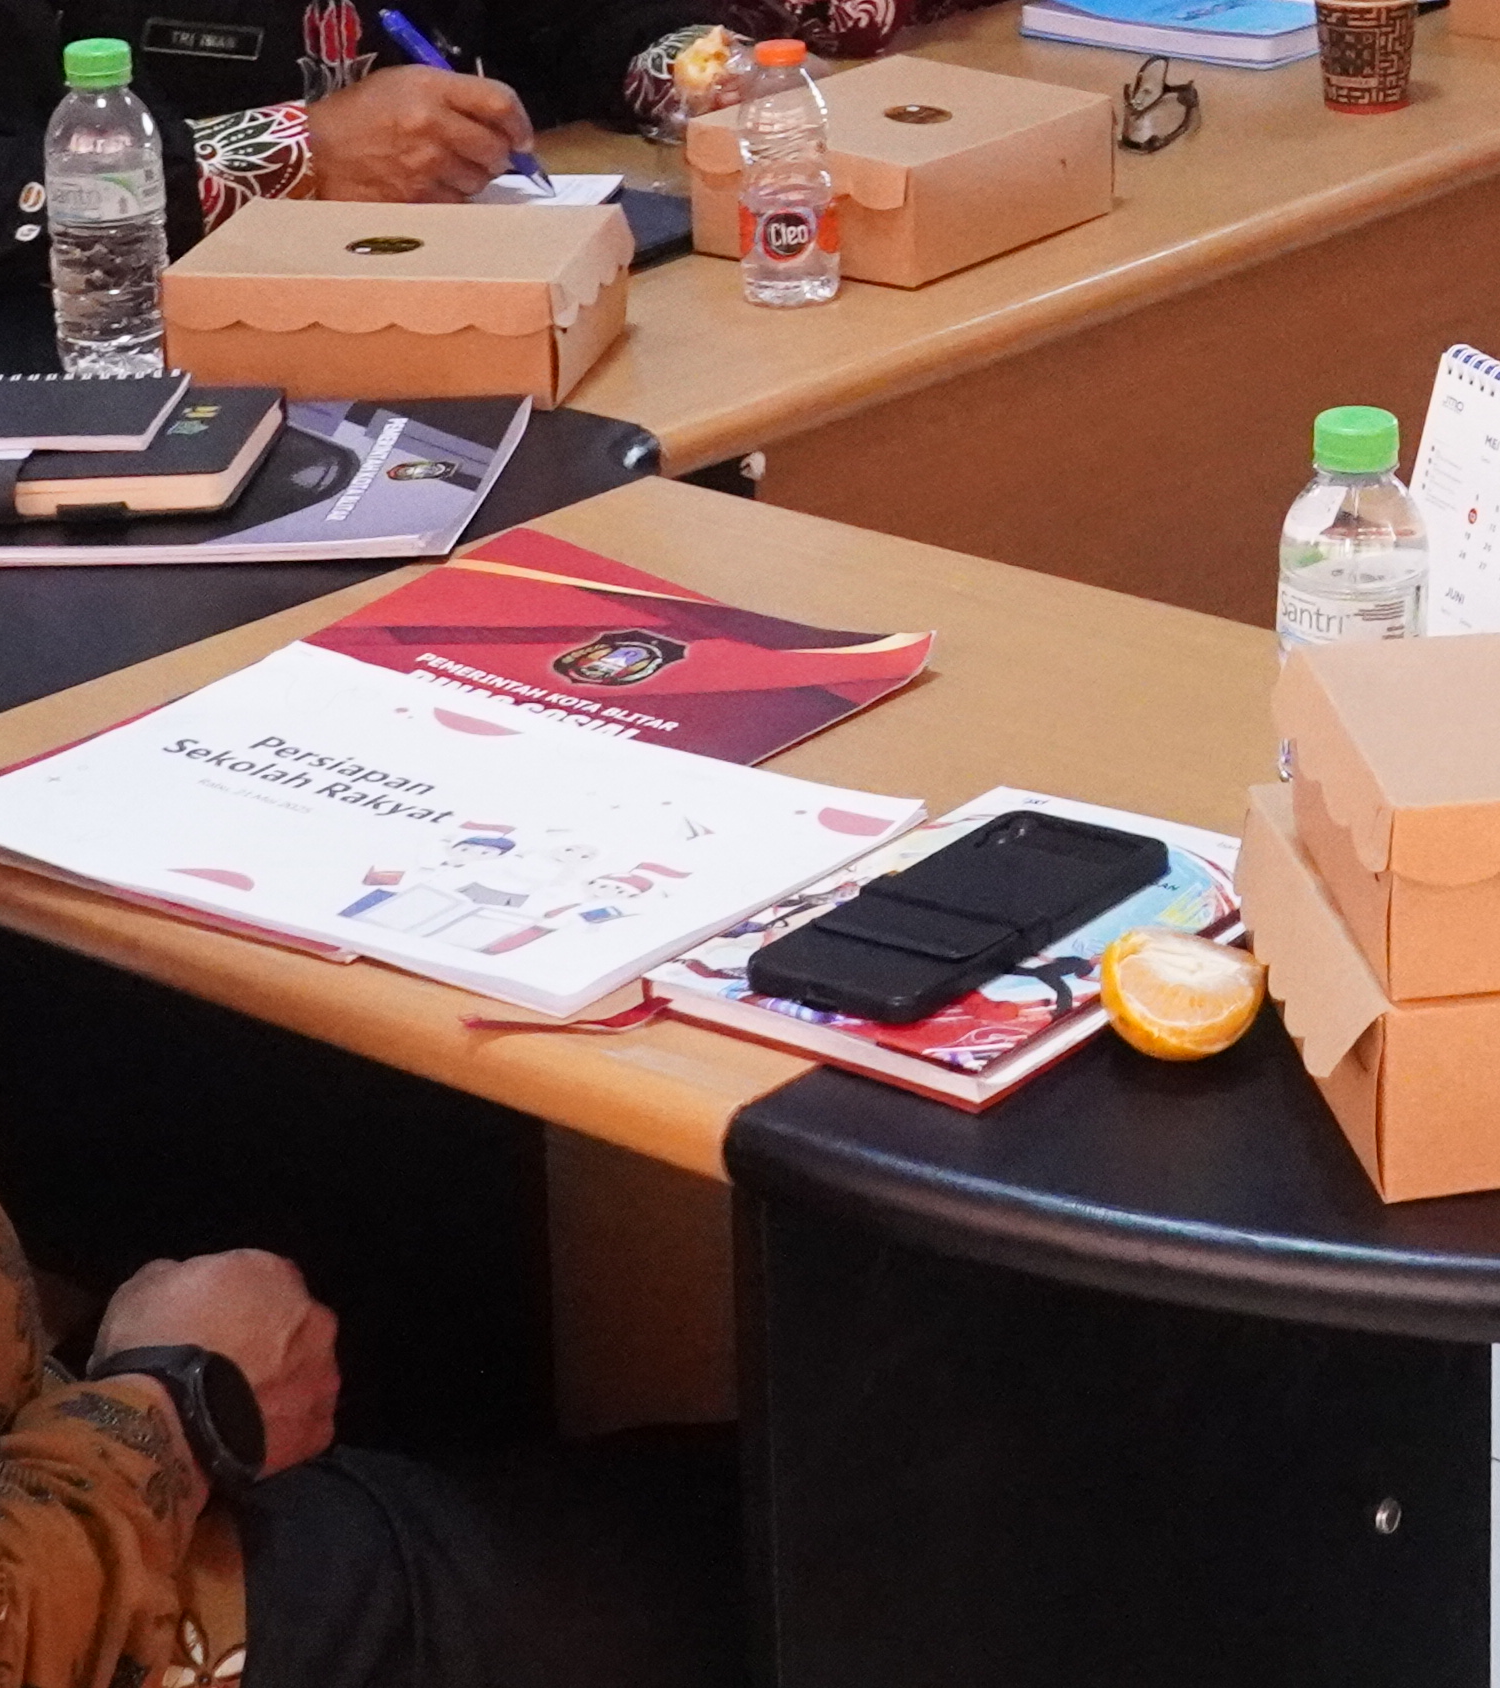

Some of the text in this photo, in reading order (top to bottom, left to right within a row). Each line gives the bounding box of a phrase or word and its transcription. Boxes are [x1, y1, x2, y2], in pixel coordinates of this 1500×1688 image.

[769, 223, 809, 246] Cleo
[1484, 434, 1500, 452] MEI
[1281, 590, 1345, 635] Santri
[1445, 586, 1465, 606] JUNI
[415, 651, 680, 733] PEMERINTAH KOTA BLITAR
[163, 738, 454, 825] Sekolah Rakyat
[249, 736, 436, 795] Persiapan
